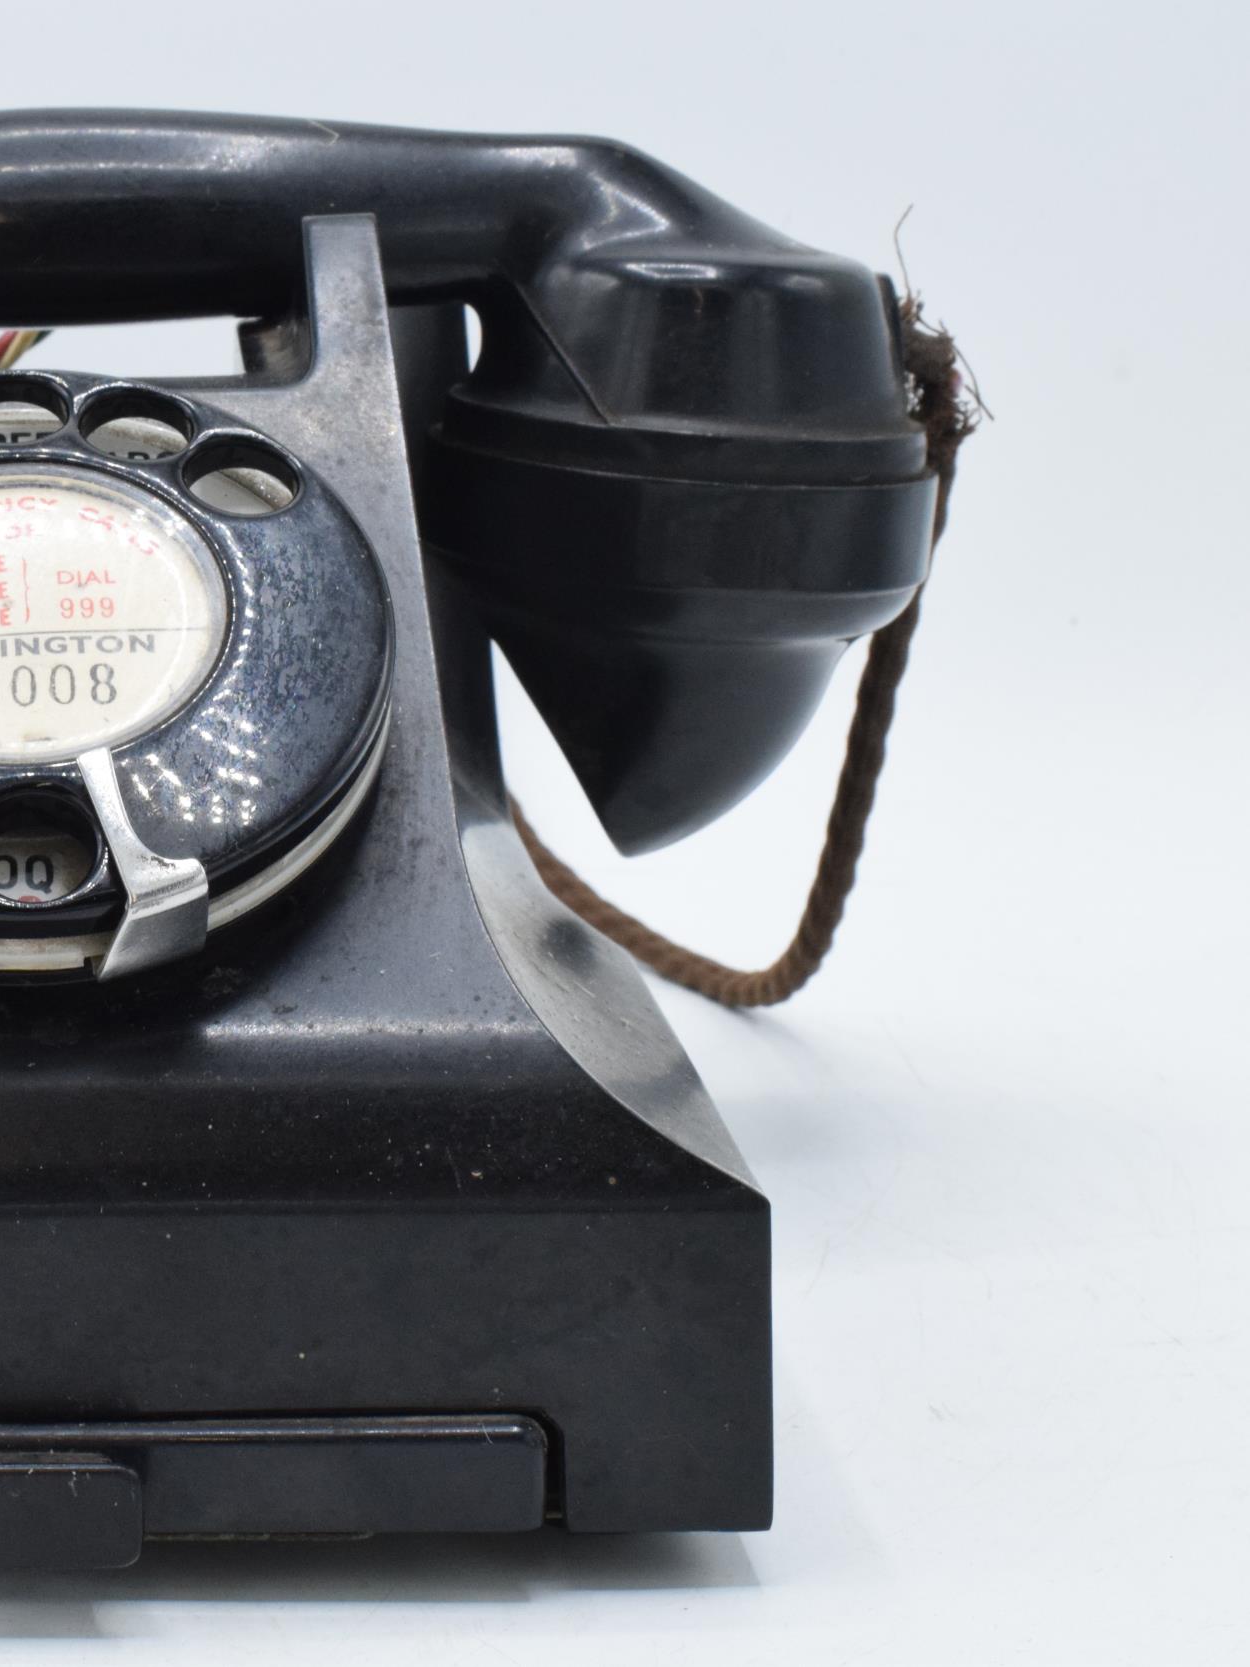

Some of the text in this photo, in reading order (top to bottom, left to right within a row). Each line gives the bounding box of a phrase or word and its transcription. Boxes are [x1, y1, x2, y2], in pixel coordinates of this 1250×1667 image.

[79, 506, 160, 556] CALS
[56, 570, 117, 586] DIAL
[60, 597, 116, 620] 999
